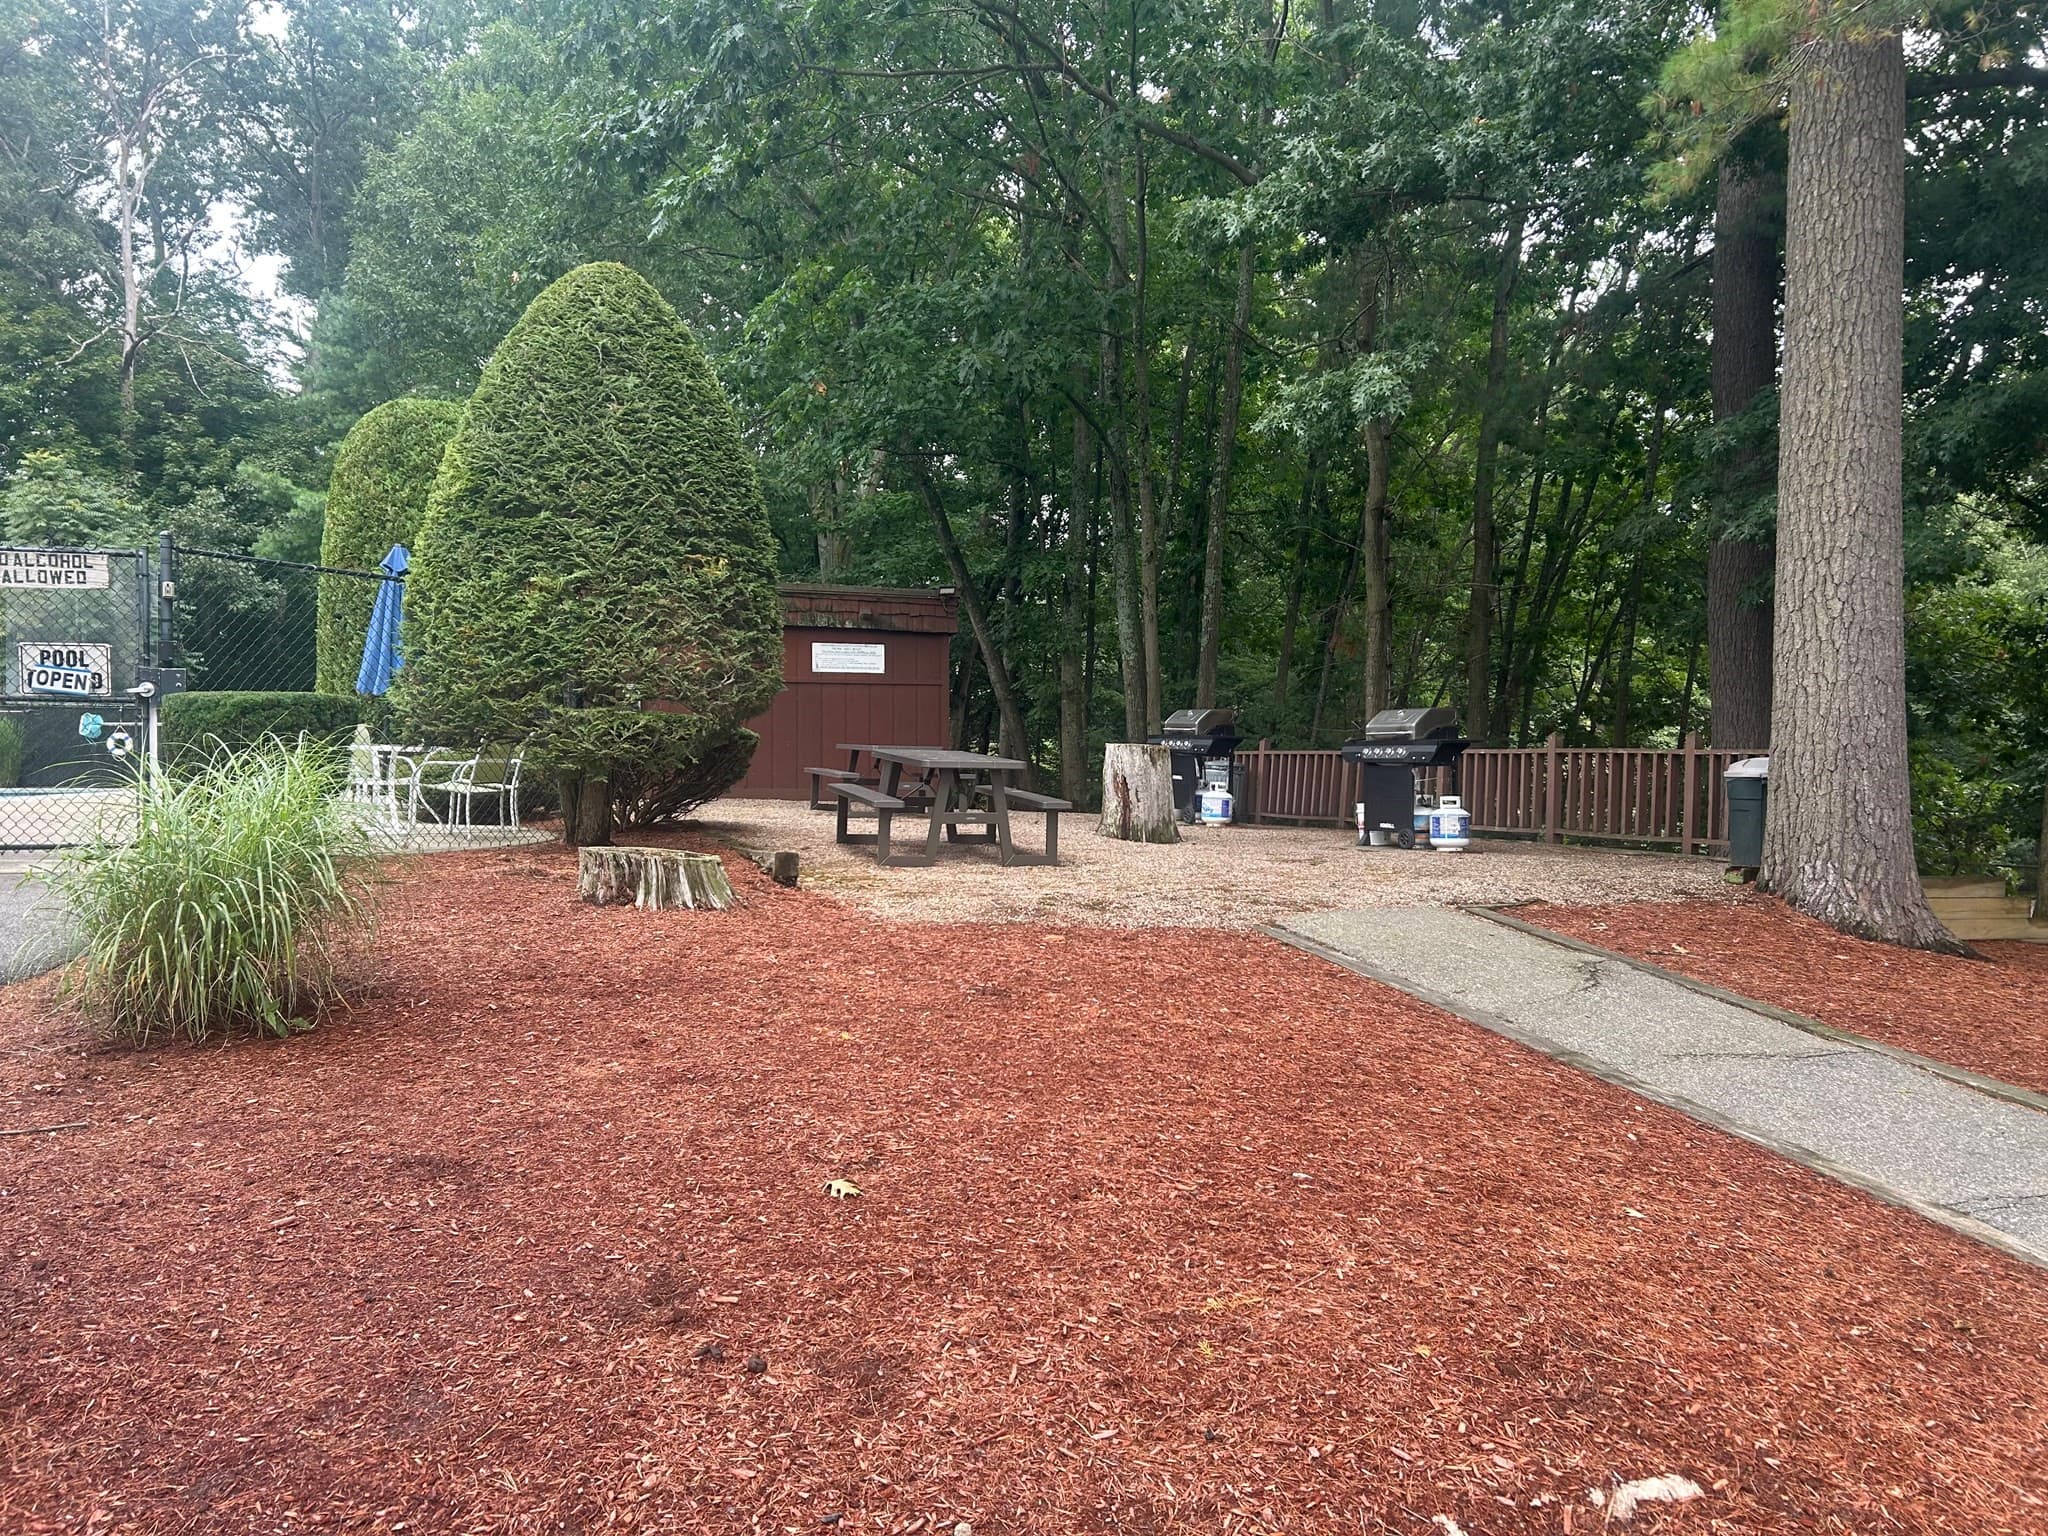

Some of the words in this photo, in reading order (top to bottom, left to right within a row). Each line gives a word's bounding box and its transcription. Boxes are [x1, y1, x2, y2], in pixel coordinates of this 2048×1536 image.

[14, 553, 93, 568] ALCOHOL
[2, 569, 87, 584] ALLOWED
[40, 649, 89, 667] POOL
[36, 670, 87, 690] OPEN
